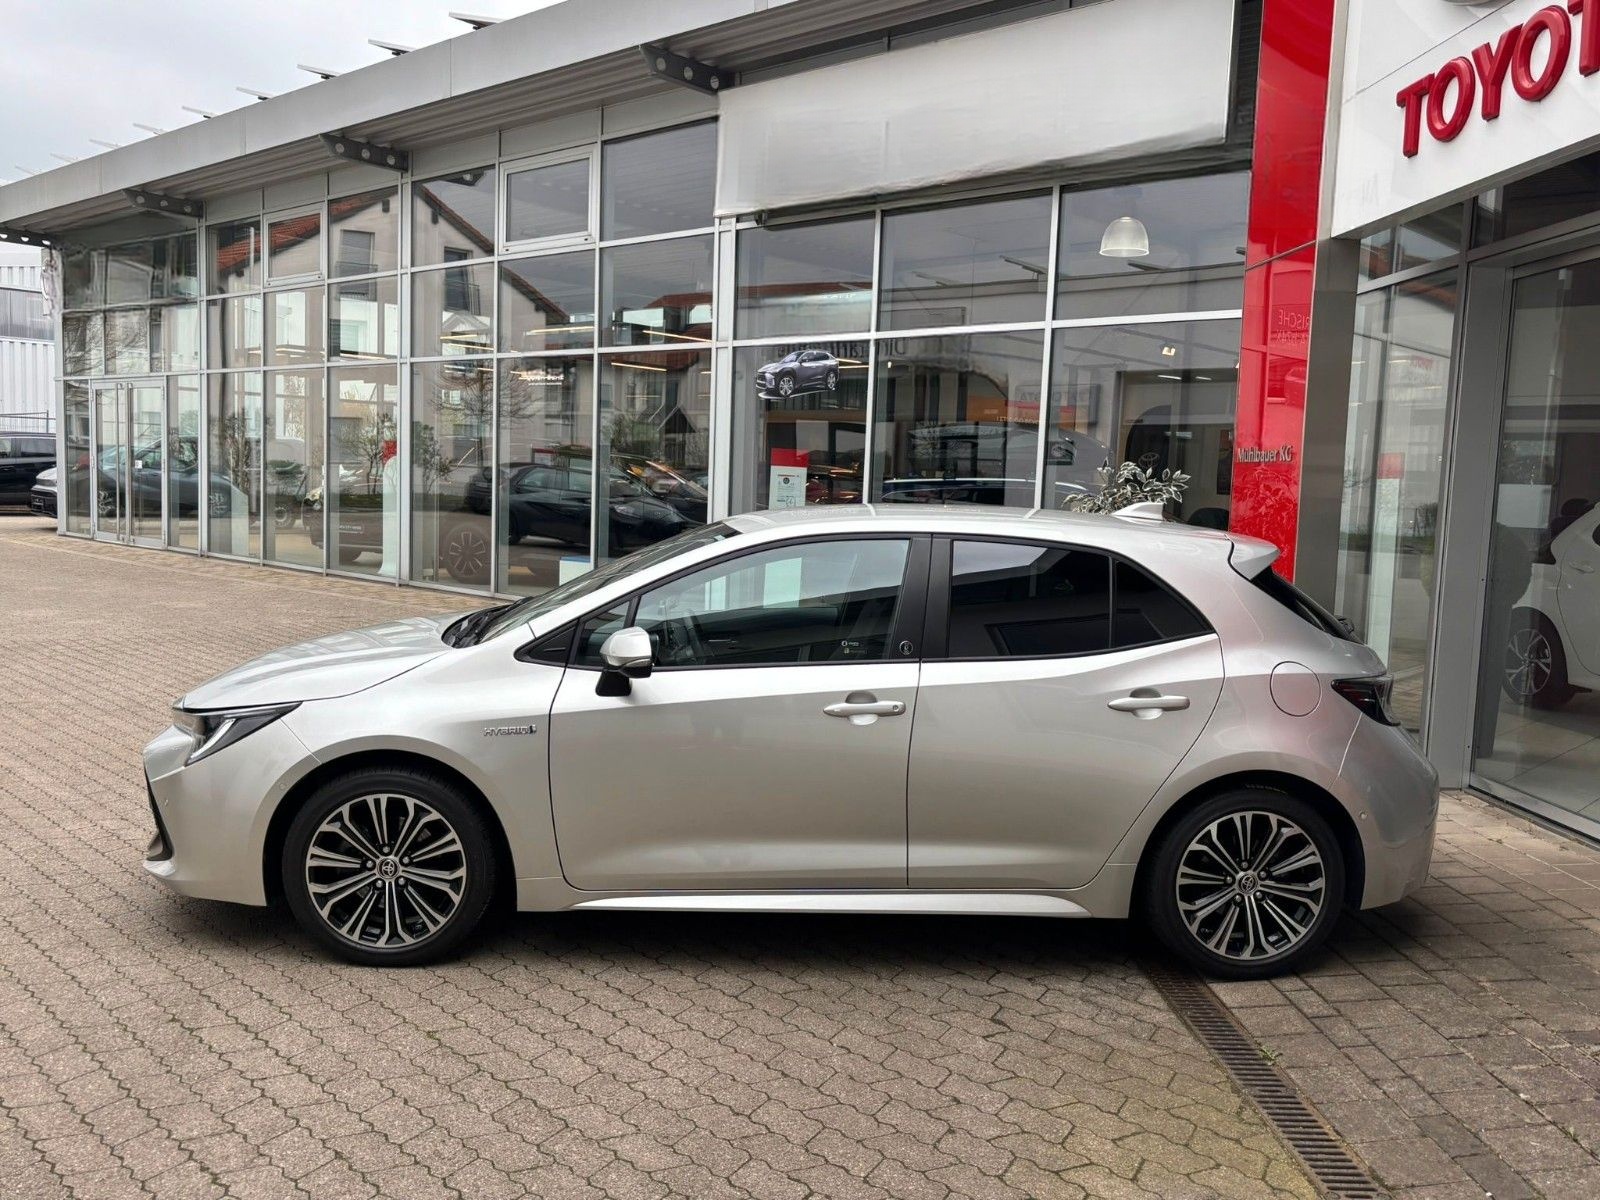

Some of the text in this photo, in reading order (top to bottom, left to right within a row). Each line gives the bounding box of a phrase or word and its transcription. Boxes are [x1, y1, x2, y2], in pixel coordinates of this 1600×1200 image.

[1237, 444, 1293, 463] Mühlbauer KG
[483, 726, 528, 736] HYBRID
